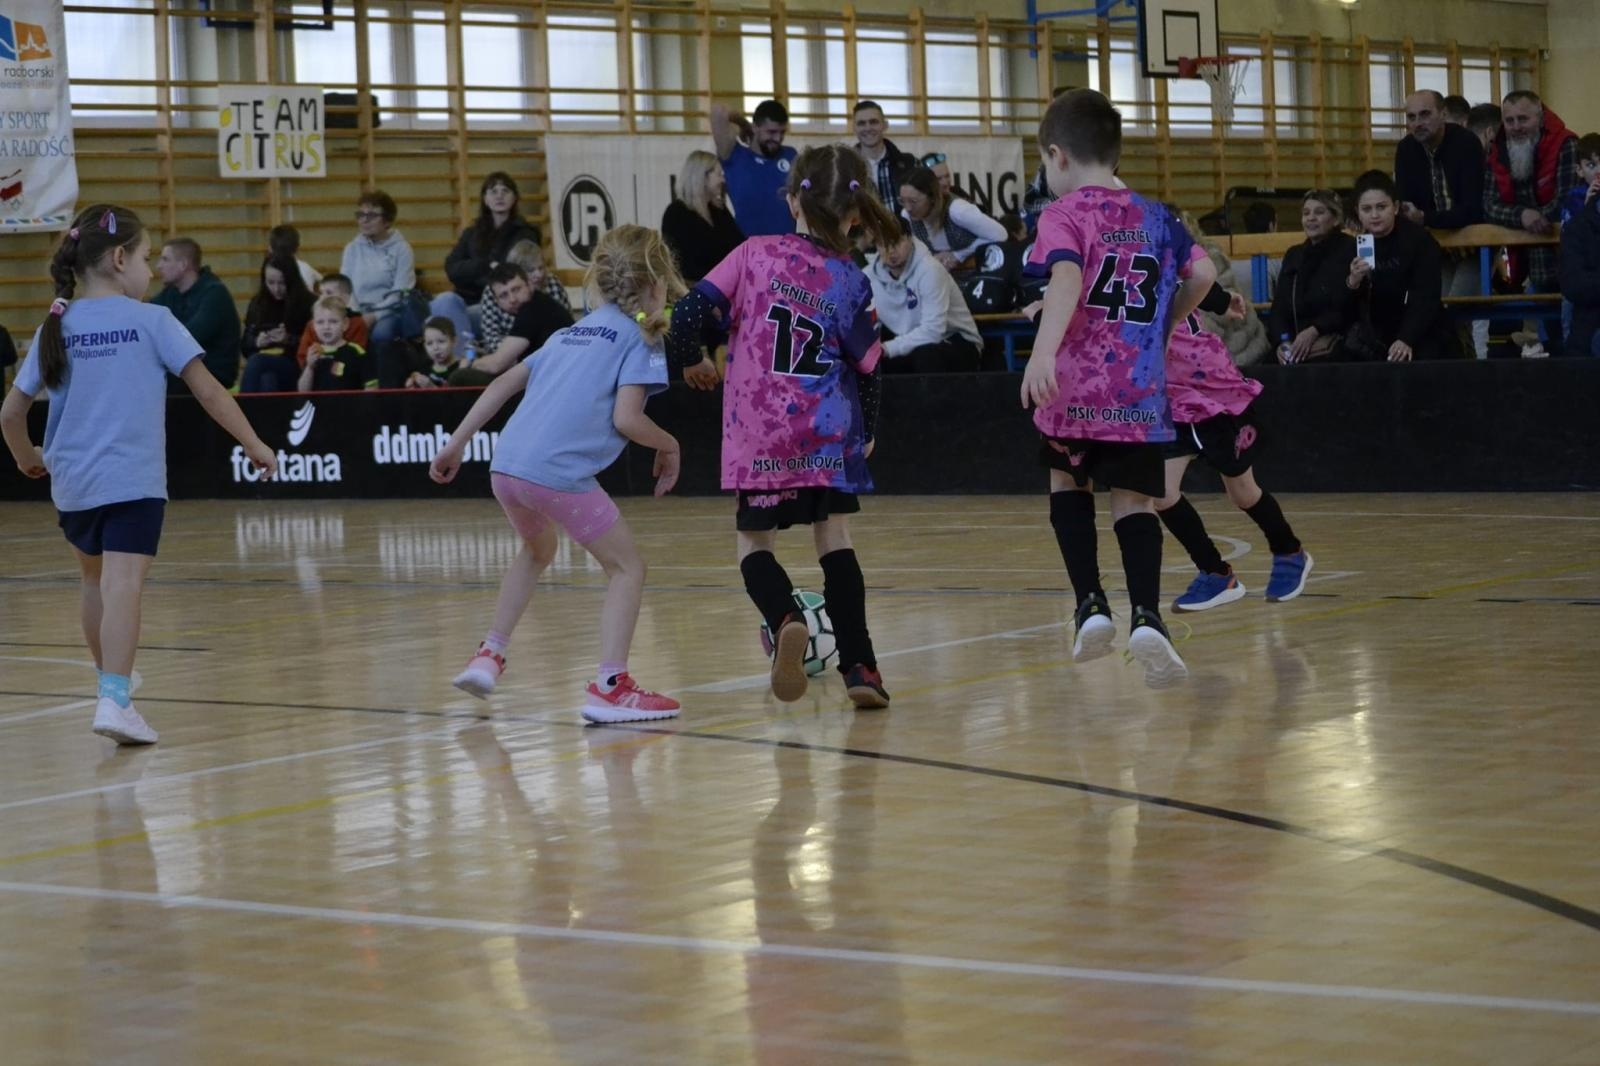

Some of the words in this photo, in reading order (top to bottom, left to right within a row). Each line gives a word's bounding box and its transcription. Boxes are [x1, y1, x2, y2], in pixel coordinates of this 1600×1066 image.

[8, 111, 50, 130] SPORT
[230, 98, 318, 131] TEAM
[225, 132, 322, 173] CITRUS
[770, 277, 836, 315] DANIELKA
[1085, 252, 1160, 326] 43
[63, 329, 140, 349] UPERNOVA
[764, 302, 834, 379] 12
[1066, 405, 1097, 421] MSK
[1101, 407, 1157, 425] ORLOVA
[231, 444, 343, 483] fotana
[752, 457, 782, 473] MSK
[786, 455, 845, 472] ORLOVA
